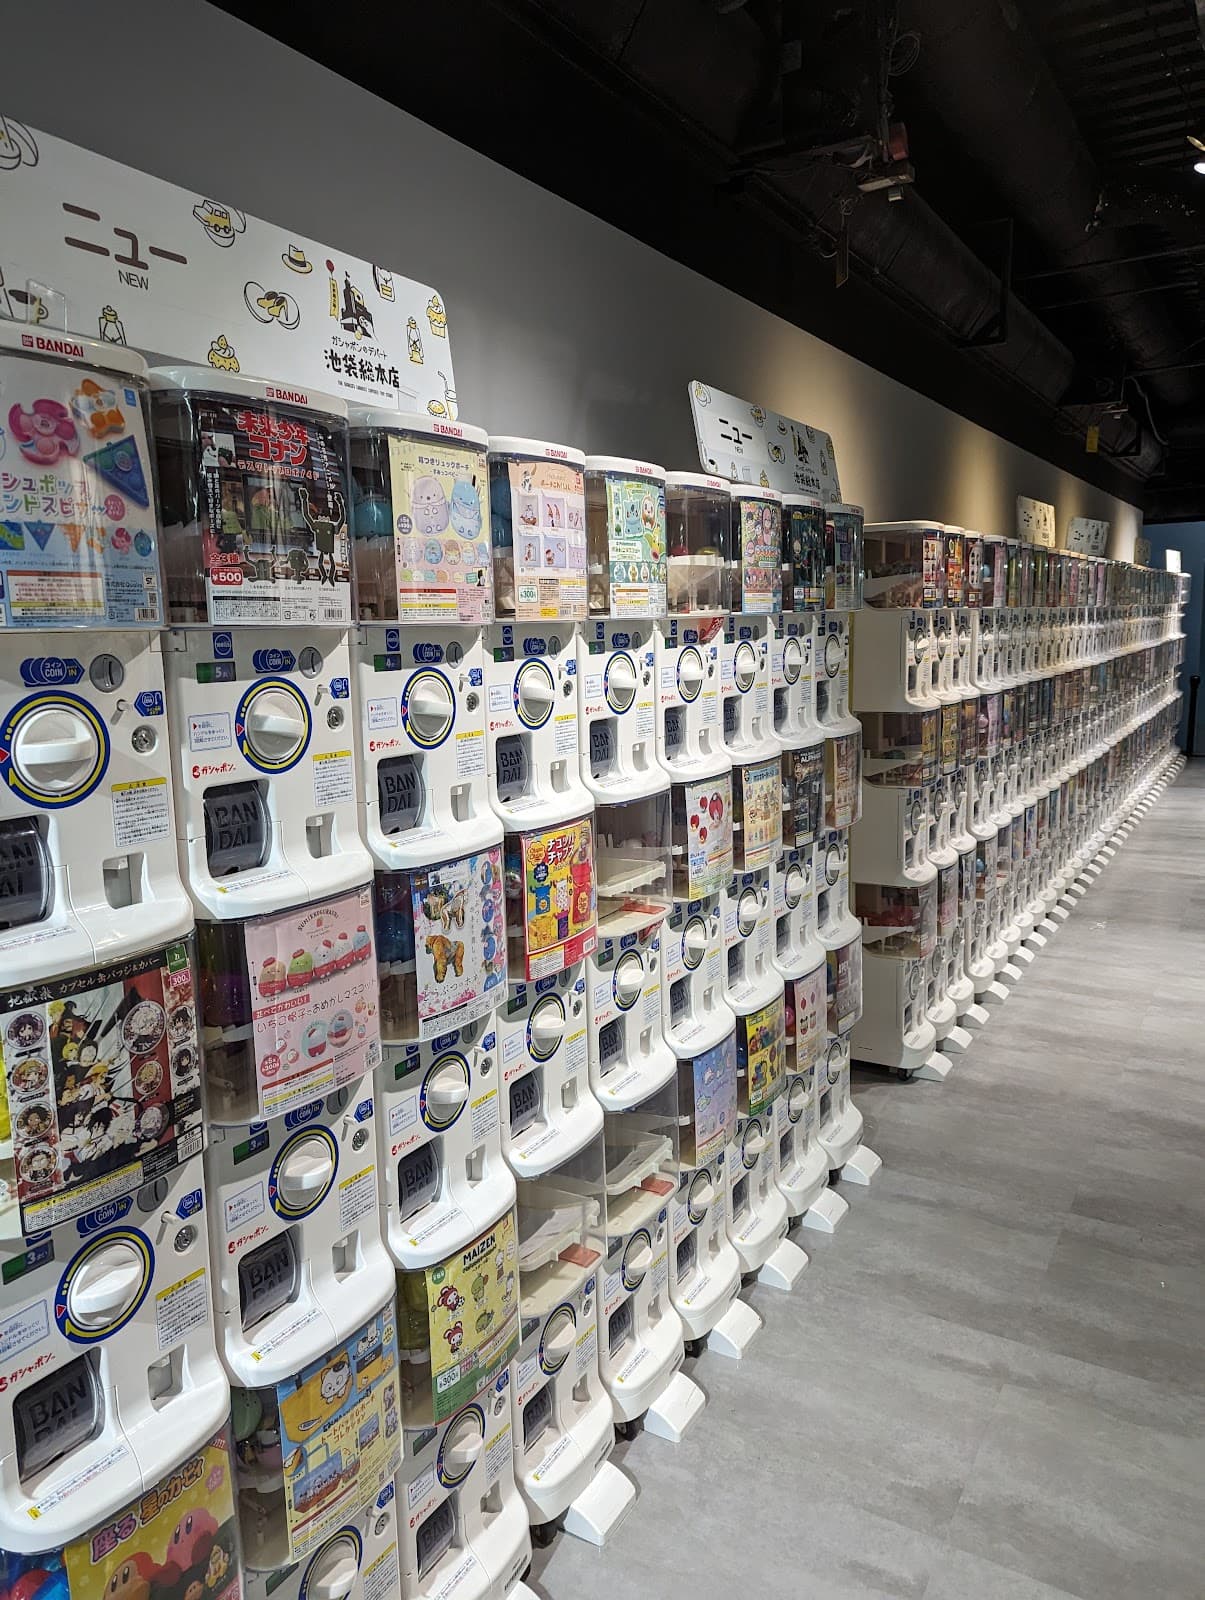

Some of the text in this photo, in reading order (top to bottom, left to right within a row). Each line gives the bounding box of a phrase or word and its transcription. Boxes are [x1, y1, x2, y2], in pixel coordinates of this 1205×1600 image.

[62, 202, 187, 270] ニュー
[118, 270, 149, 291] NEW
[36, 337, 84, 358] BANDAI
[331, 335, 388, 360] ガシャポンのデパート
[324, 348, 400, 388] 池袋総本店
[276, 389, 308, 405] BANDAI
[236, 410, 309, 447] 未来少年
[440, 425, 463, 437] BANDAI
[718, 418, 752, 444] ニュー
[248, 433, 308, 465] コナン
[550, 449, 568, 459] BANDAI
[209, 552, 240, 564] 全3種
[211, 571, 242, 583] ¥500
[44, 668, 77, 677] COIN IN
[376, 741, 401, 751] ガシャポン
[201, 763, 232, 775] ガシャポン
[500, 749, 522, 768] BAN
[385, 772, 416, 796] BAN
[502, 766, 521, 784] DAI
[214, 800, 259, 828] BAN
[387, 794, 414, 814] DAI
[218, 826, 251, 850] DAI
[7, 985, 54, 1008] 地獄楽
[513, 1084, 535, 1109] BAN
[397, 1134, 421, 1152] ガシャポン
[404, 1155, 434, 1187] BAN
[98, 1208, 114, 1222] COIN
[236, 1225, 269, 1249] ガシャポン
[463, 1232, 496, 1266] MAIZEN
[251, 1248, 289, 1289] BAN
[10, 1352, 56, 1383] ガシャポン
[29, 1376, 87, 1430] BAN
[421, 1506, 455, 1550] BAN
